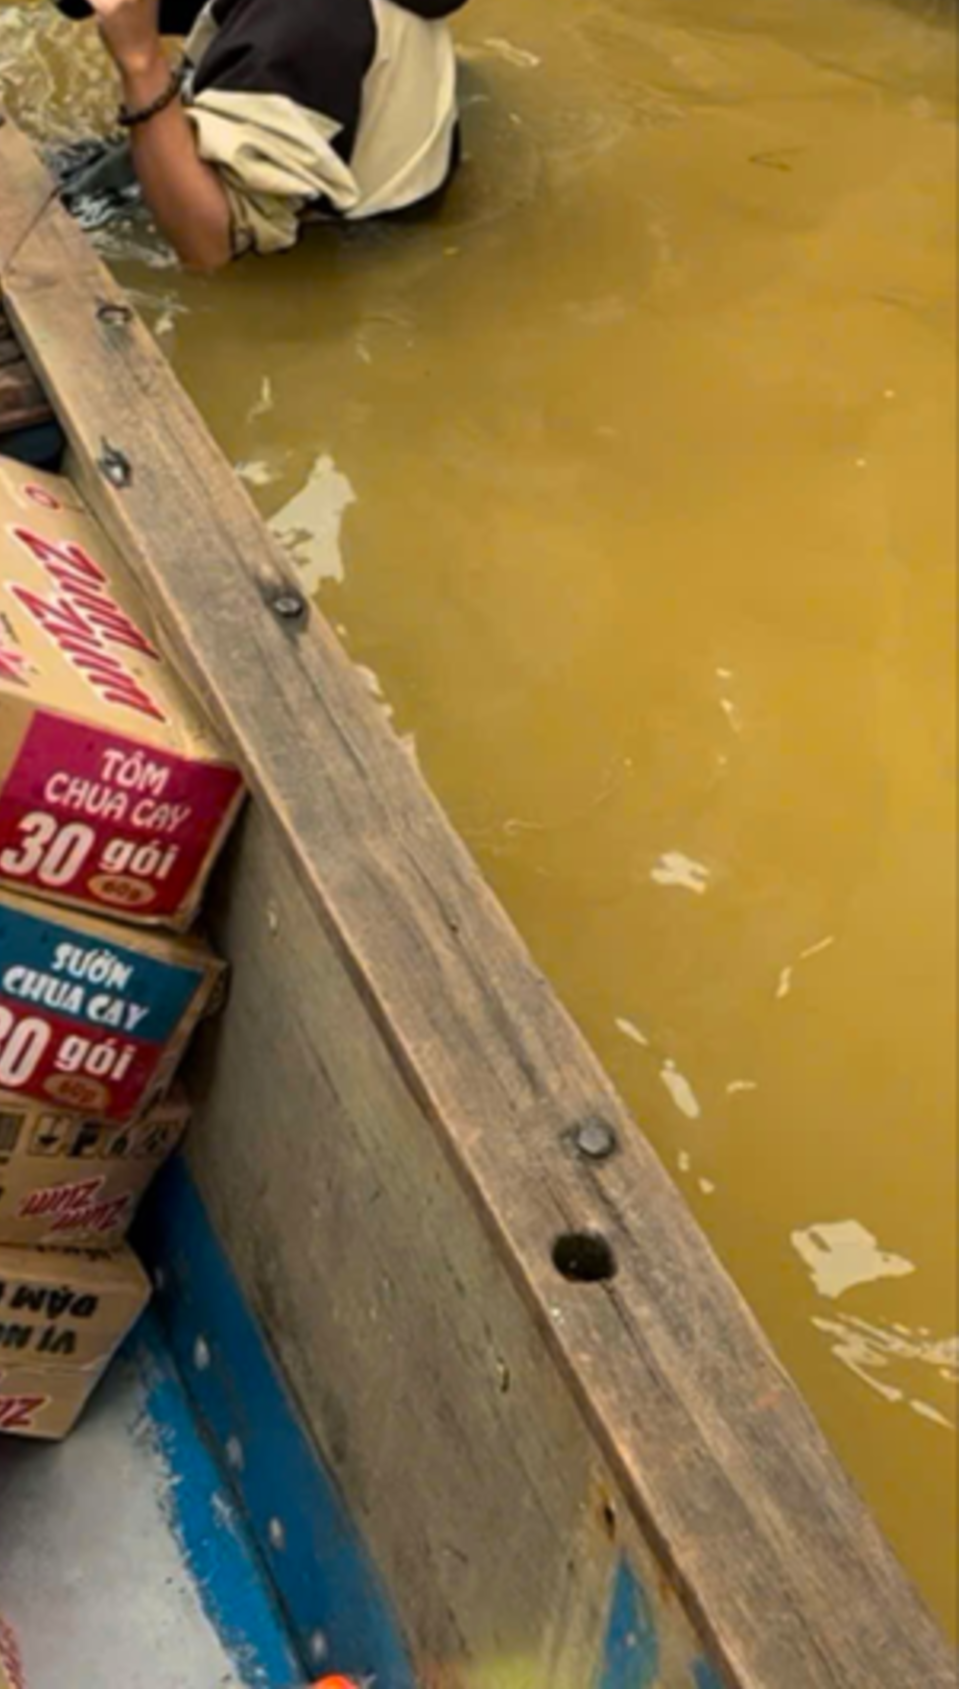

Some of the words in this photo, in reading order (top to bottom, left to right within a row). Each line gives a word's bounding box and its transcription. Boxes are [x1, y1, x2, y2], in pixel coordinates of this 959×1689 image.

[100, 747, 171, 797] TÔM
[43, 771, 129, 821] CHUA
[131, 797, 192, 833] CAY
[98, 837, 180, 880] gói
[1, 965, 86, 1014] CHUA
[86, 993, 150, 1032] CAY
[53, 1033, 137, 1082] gói
